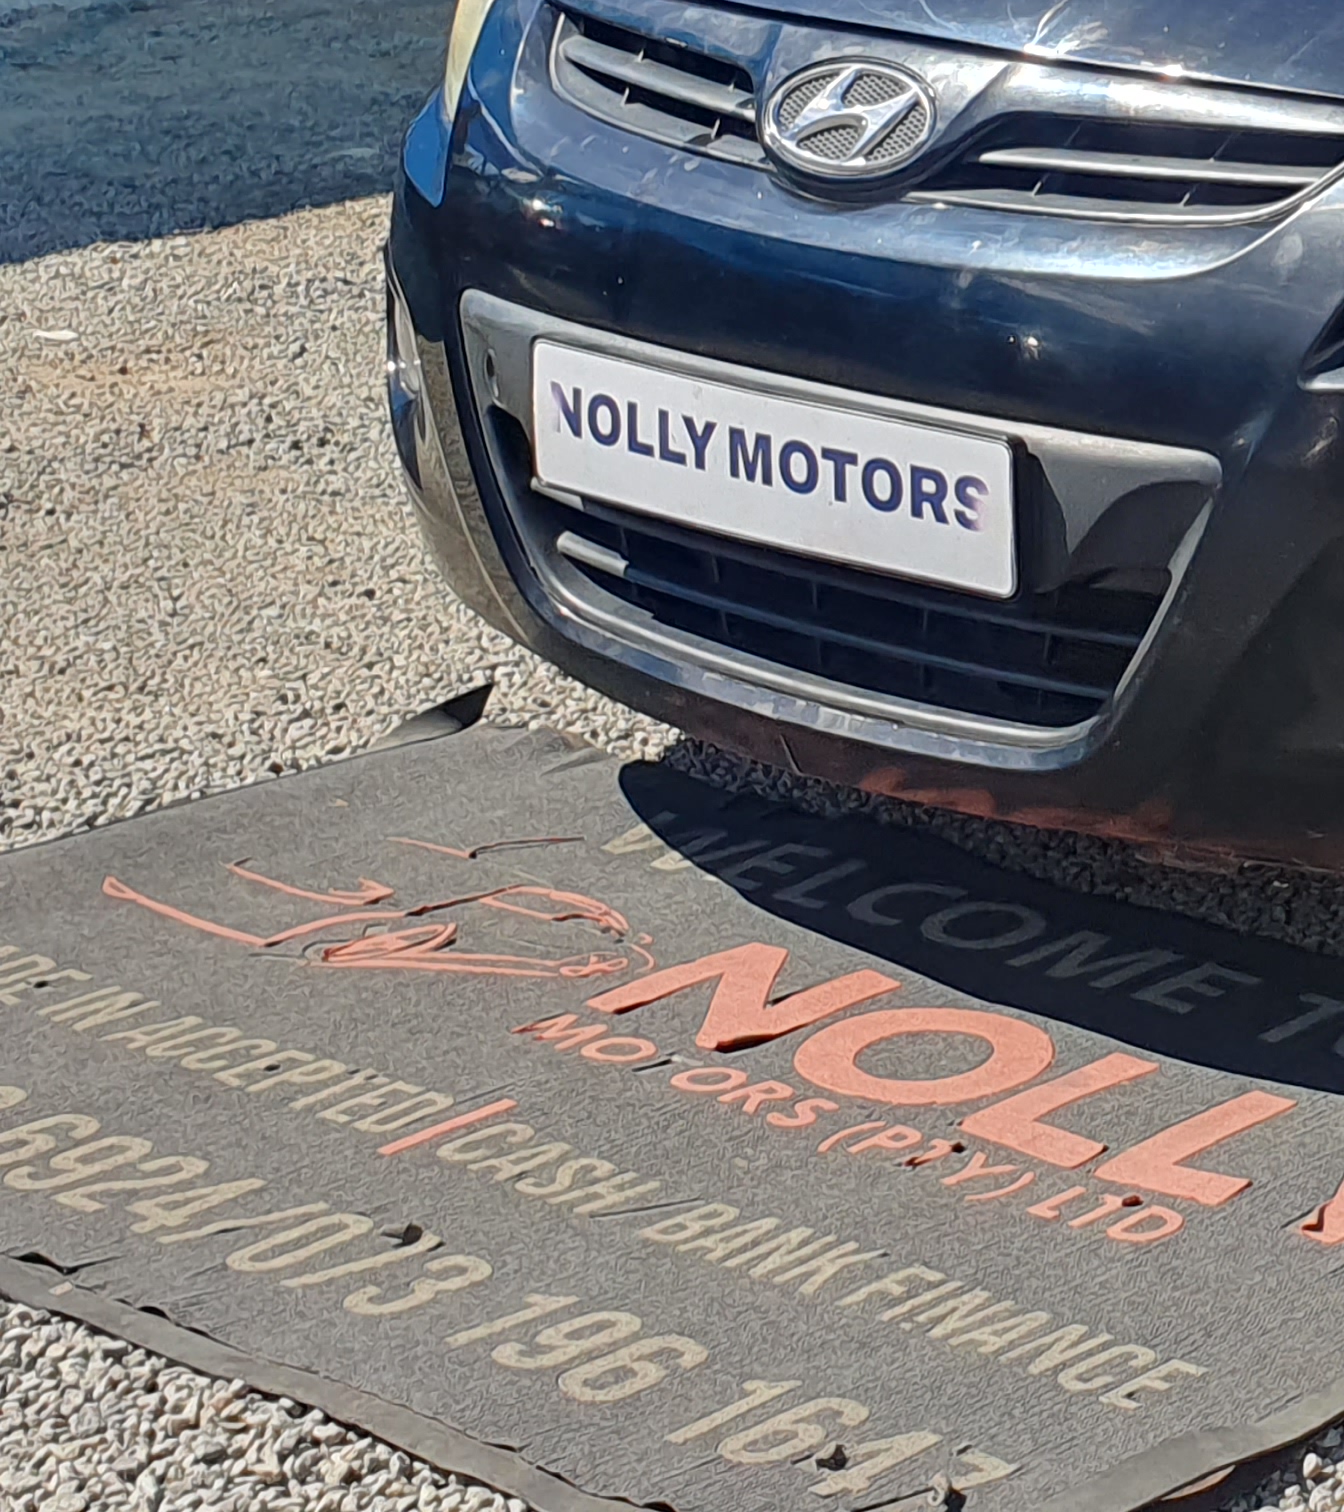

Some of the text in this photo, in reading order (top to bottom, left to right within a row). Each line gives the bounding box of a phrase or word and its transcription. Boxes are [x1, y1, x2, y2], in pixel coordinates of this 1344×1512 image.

[550, 380, 989, 532] NOLLY MOTORS
[600, 811, 1263, 1015] WELCOME
[38, 985, 162, 1033] IN
[834, 1263, 1209, 1413] FINANCE
[1025, 1185, 1185, 1244] LTD
[443, 1292, 710, 1403] 196
